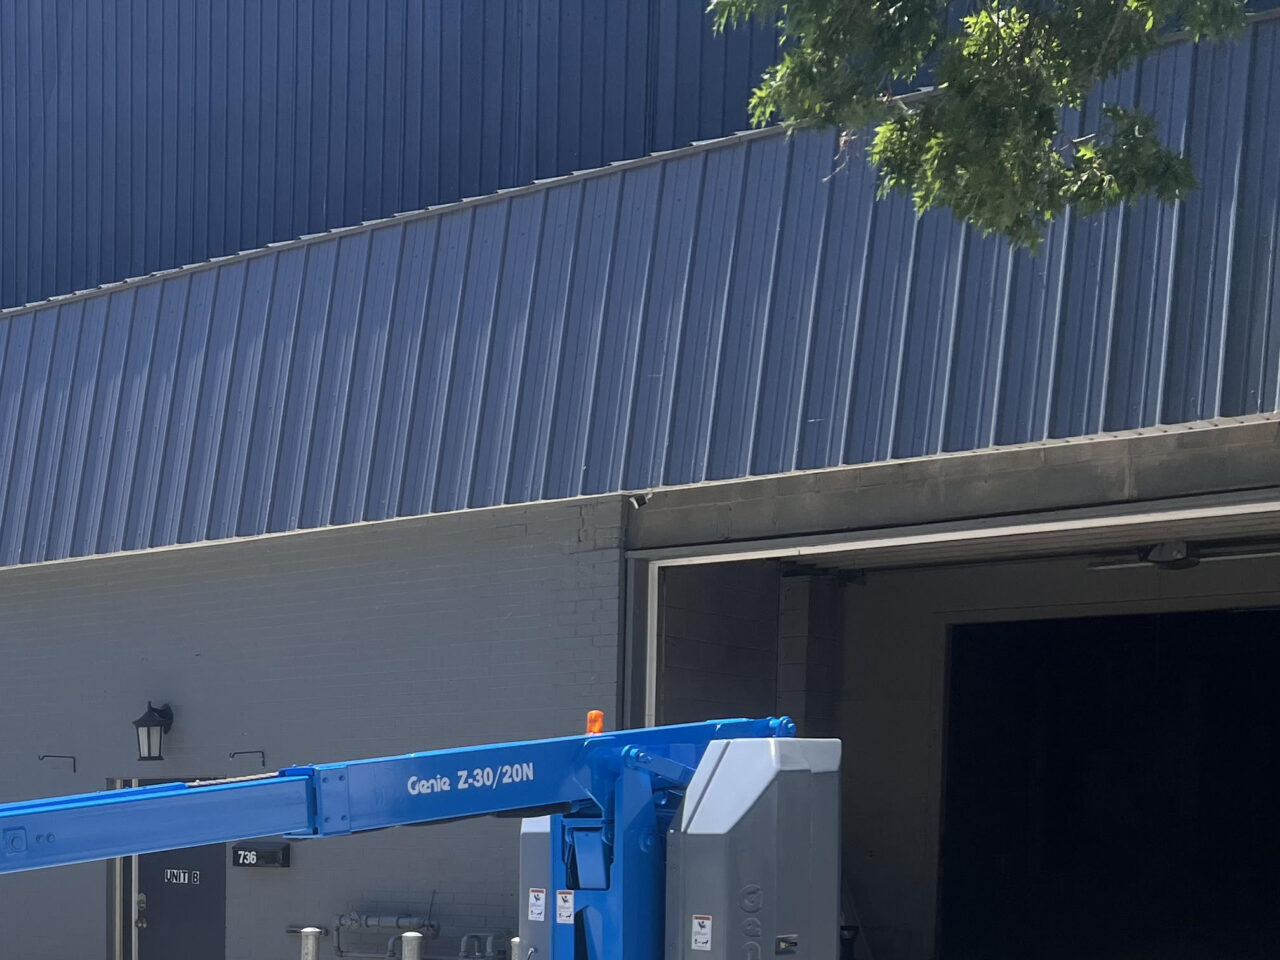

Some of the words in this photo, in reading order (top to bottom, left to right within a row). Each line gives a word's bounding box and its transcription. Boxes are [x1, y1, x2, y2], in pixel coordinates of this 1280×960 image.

[407, 774, 451, 795] Genie
[457, 762, 534, 790] Z-30/20N
[238, 851, 257, 864] 736
[164, 869, 189, 884] UNIT
[191, 871, 200, 884] B
